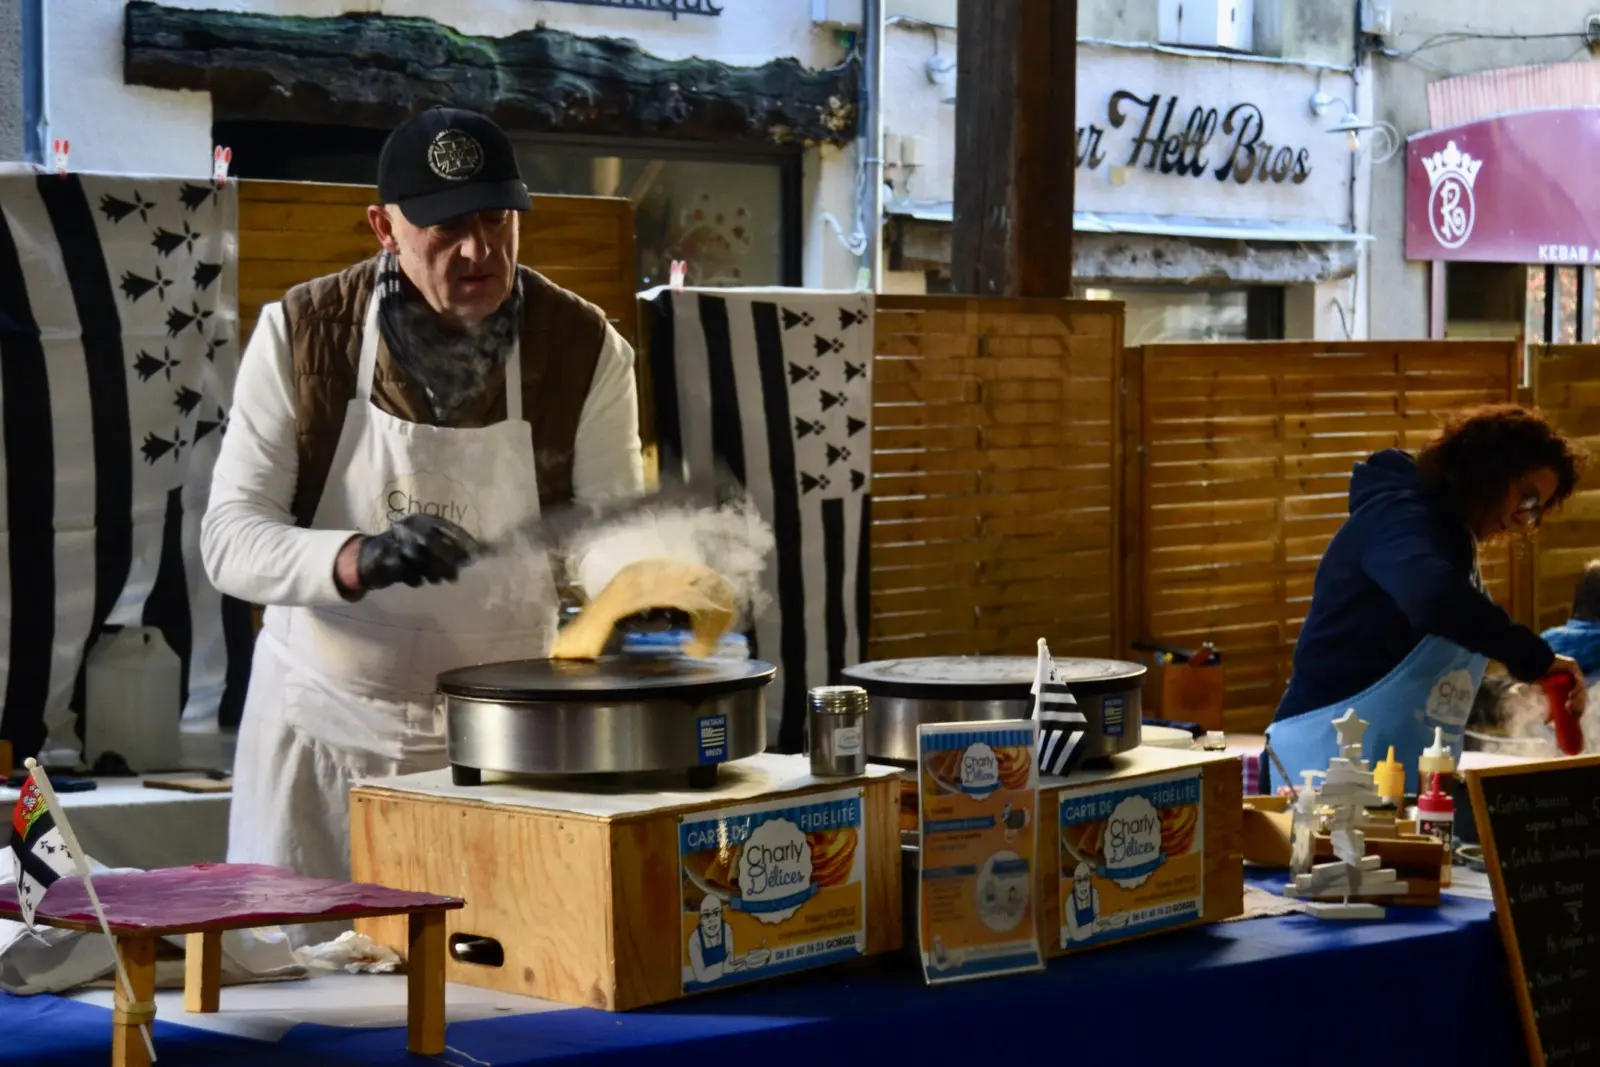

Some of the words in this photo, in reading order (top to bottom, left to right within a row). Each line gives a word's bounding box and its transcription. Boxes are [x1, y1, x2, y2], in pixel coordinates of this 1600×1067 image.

[1108, 90, 1217, 177] Hell
[1215, 103, 1312, 184] Bros
[1538, 244, 1588, 261] KEBAB
[387, 490, 468, 523] Charly
[801, 803, 856, 829] FIDÉLITÉ
[1065, 804, 1096, 820] CARTE
[1100, 800, 1112, 815] DE
[1111, 815, 1154, 837] Charly
[747, 840, 804, 866] Charly
[747, 865, 806, 895] Délices
